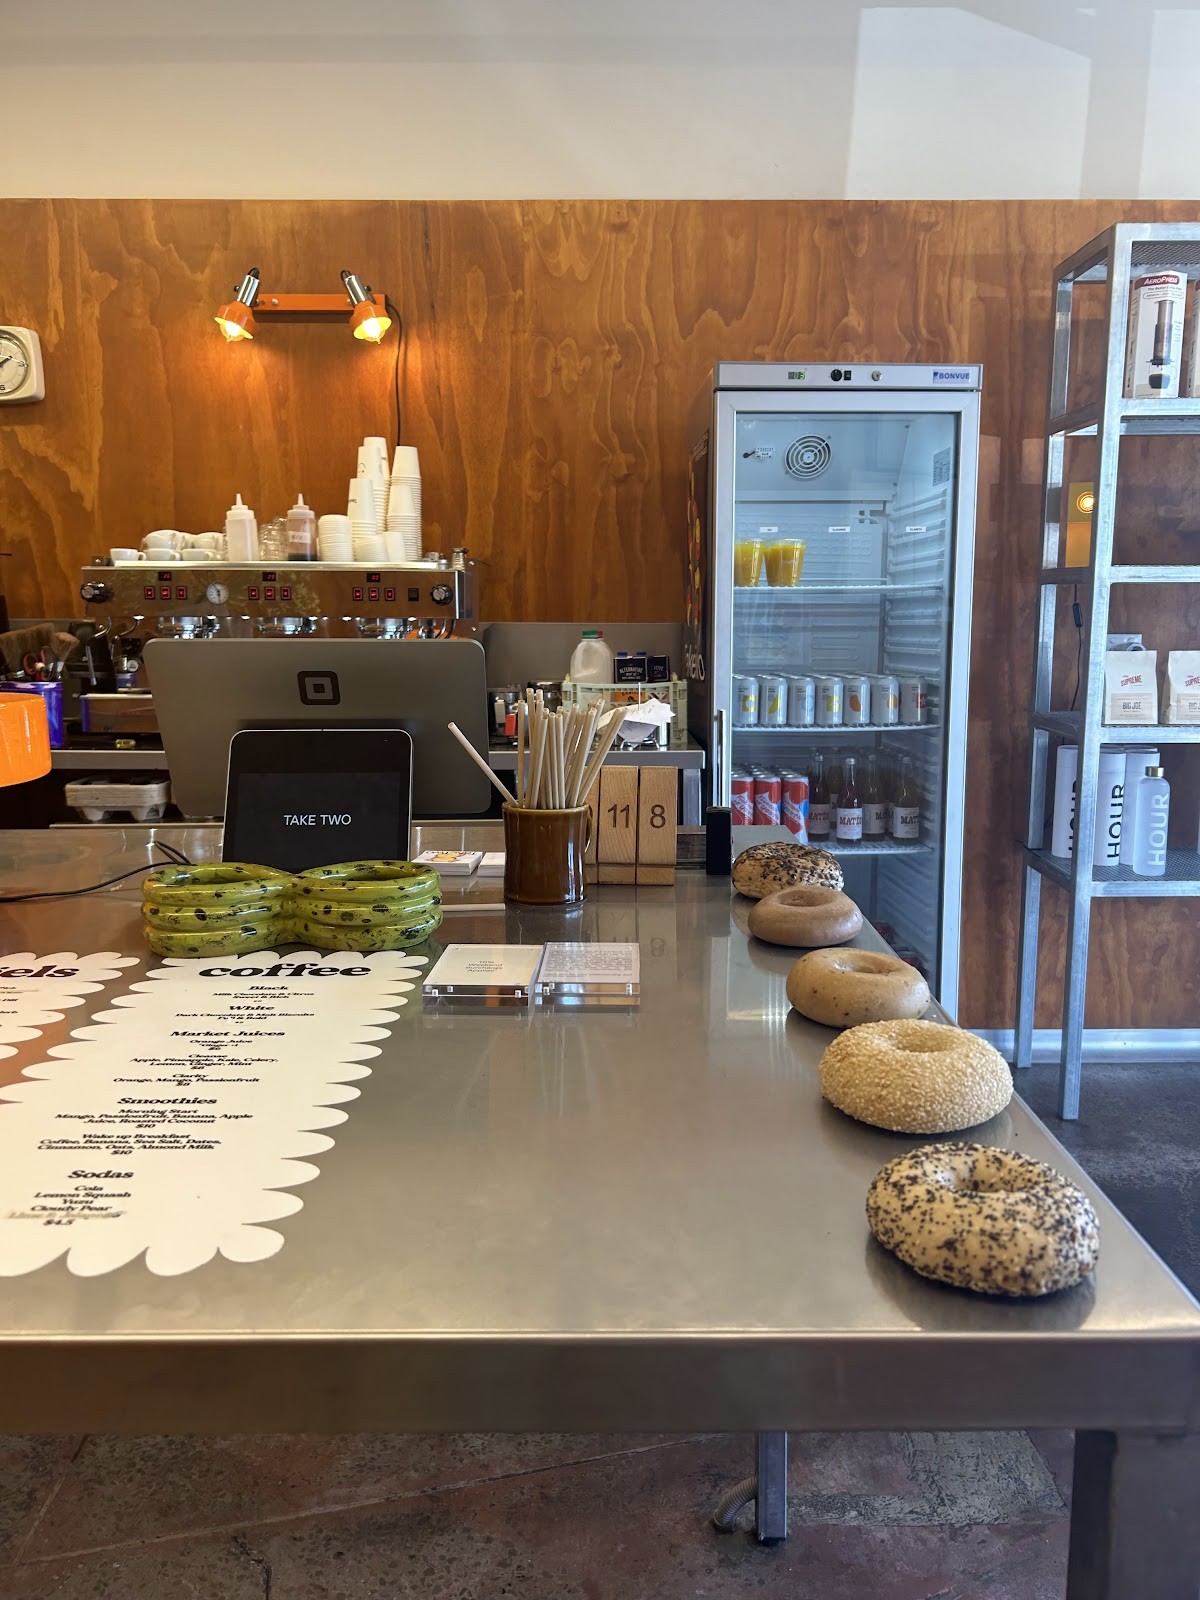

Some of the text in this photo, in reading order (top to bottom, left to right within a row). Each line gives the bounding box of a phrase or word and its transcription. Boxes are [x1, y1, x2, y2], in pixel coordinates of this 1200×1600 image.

[938, 372, 970, 380] BONVUE
[1120, 675, 1142, 687] SUPREME
[1122, 702, 1142, 710] BIG JOE
[283, 814, 351, 825] TAKE TWO
[607, 804, 630, 829] 11
[650, 804, 666, 829] 8
[1107, 784, 1125, 858] HOUR
[1147, 793, 1169, 866] HOUR
[0, 965, 79, 977] els
[199, 963, 371, 977] coffee
[67, 1170, 134, 1179] Sodas
